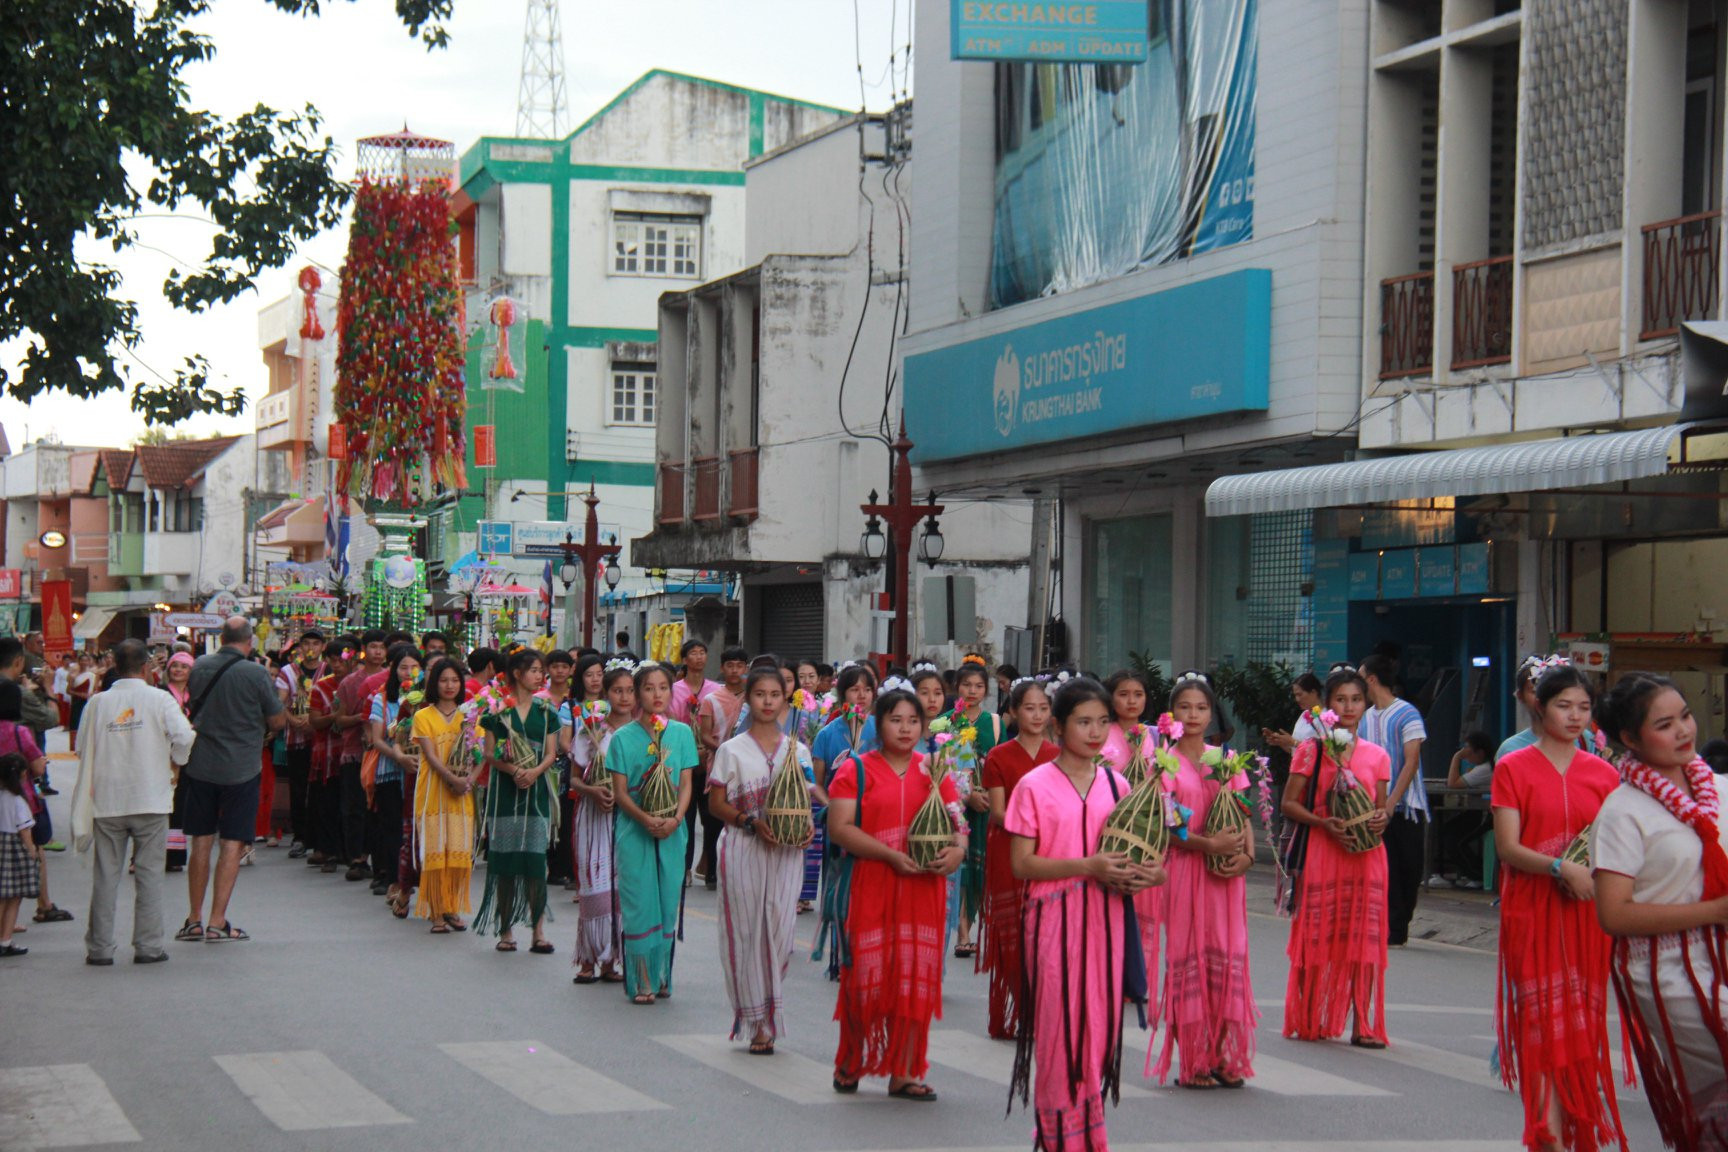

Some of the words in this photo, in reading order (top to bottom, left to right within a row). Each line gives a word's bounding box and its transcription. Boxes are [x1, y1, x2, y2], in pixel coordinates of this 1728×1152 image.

[964, 2, 1098, 25] EXCHANGE
[965, 37, 1000, 53] ATM
[1029, 40, 1066, 54] ADM
[1078, 41, 1143, 56] UPDATE
[1023, 329, 1127, 391] ธนาคารกรุงไทย
[1022, 393, 1074, 424] KRUNGTHAI
[1075, 385, 1103, 414] BANK
